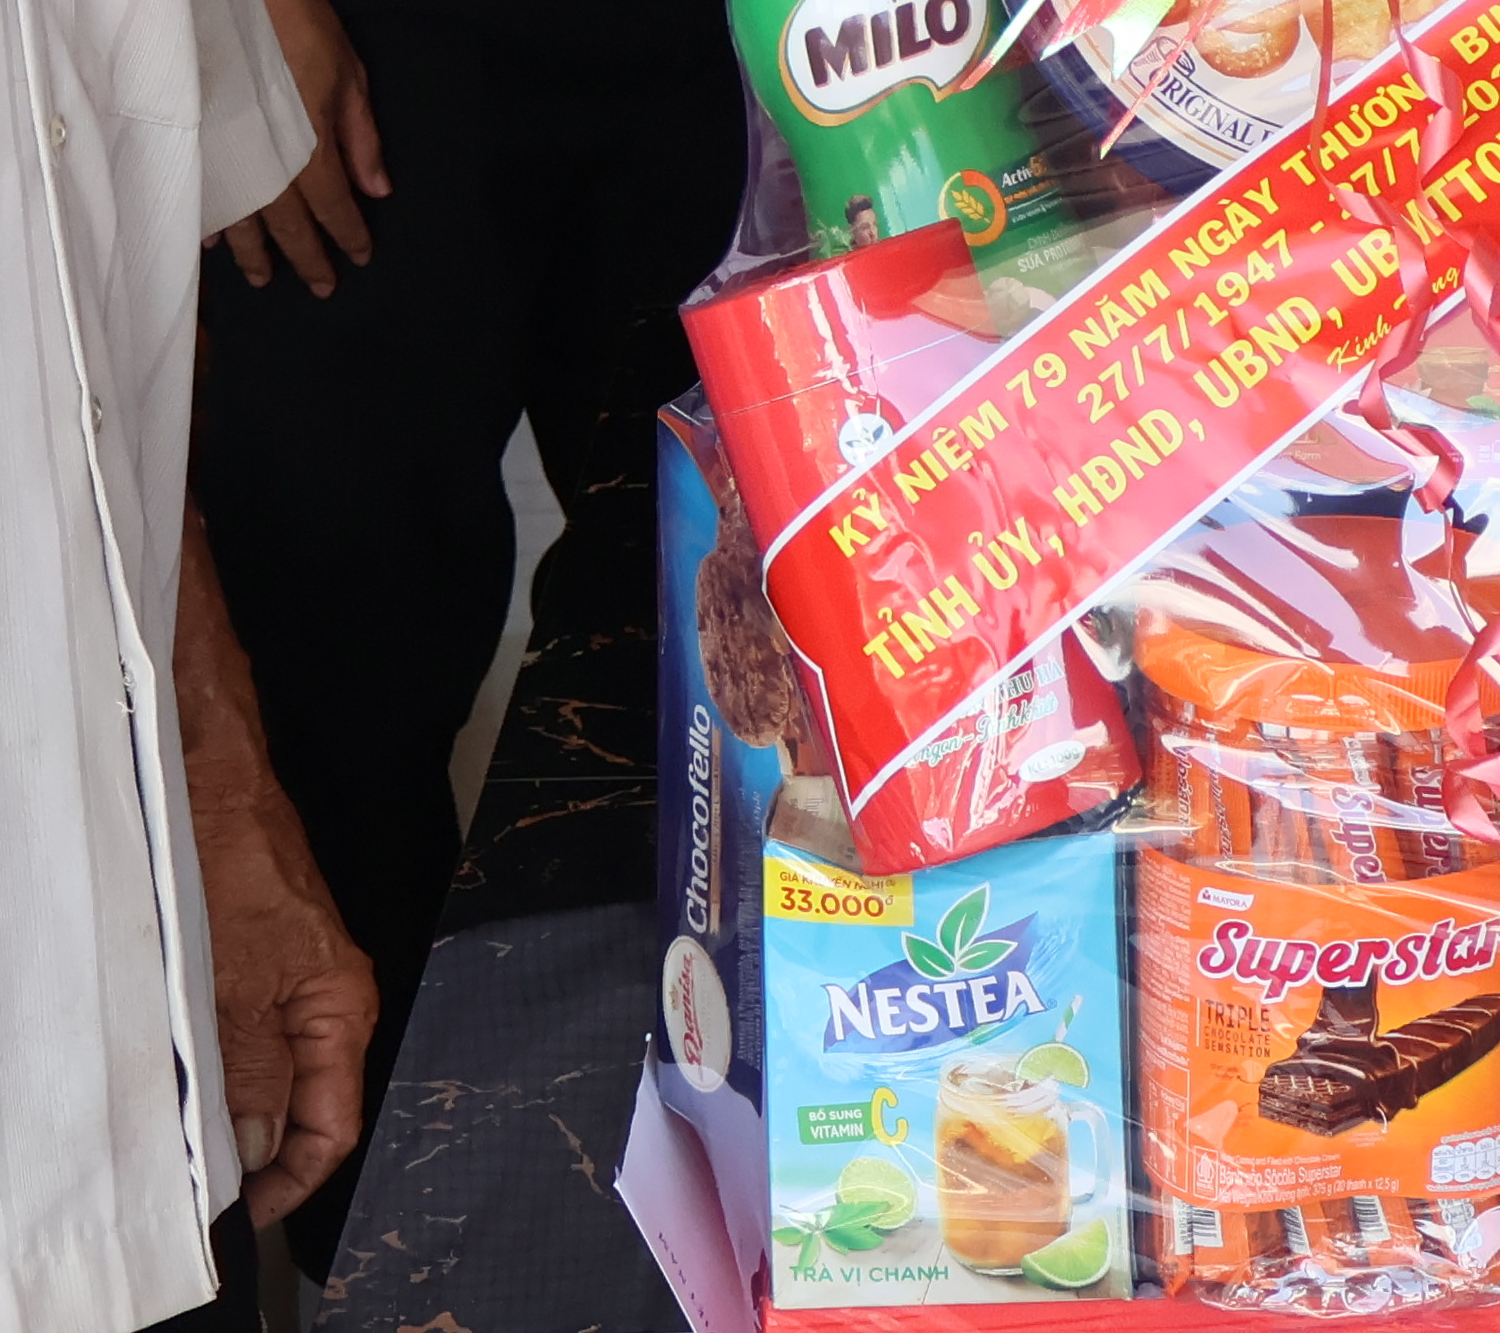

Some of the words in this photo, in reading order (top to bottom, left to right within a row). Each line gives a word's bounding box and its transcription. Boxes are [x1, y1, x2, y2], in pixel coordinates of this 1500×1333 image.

[1149, 66, 1255, 147] ORIGINAL
[828, 488, 889, 559] KỶ
[892, 400, 1010, 505] NIỆM
[1006, 352, 1068, 410] 79
[1068, 268, 1171, 360] NĂM
[1167, 177, 1281, 280] NGÀY
[1279, 55, 1440, 186] THƯƠN
[862, 573, 983, 681] TỈNH
[967, 515, 1067, 593] ỦY,
[1051, 407, 1207, 529] HĐND,
[1192, 295, 1345, 410] UBND,
[685, 703, 713, 935] Chocofello
[825, 970, 1049, 1042] NESTEA
[1203, 1025, 1271, 1046] CHOCOLATE
[1205, 998, 1271, 1033] TRIPLE
[1204, 1038, 1271, 1058] SENSATION
[810, 1122, 864, 1140] VITAMIN
[871, 1085, 908, 1147] C
[829, 1107, 863, 1122] SUNG
[789, 1261, 836, 1284] TRÀ
[839, 1266, 864, 1287] VỊ
[868, 1264, 949, 1283] CHANH
